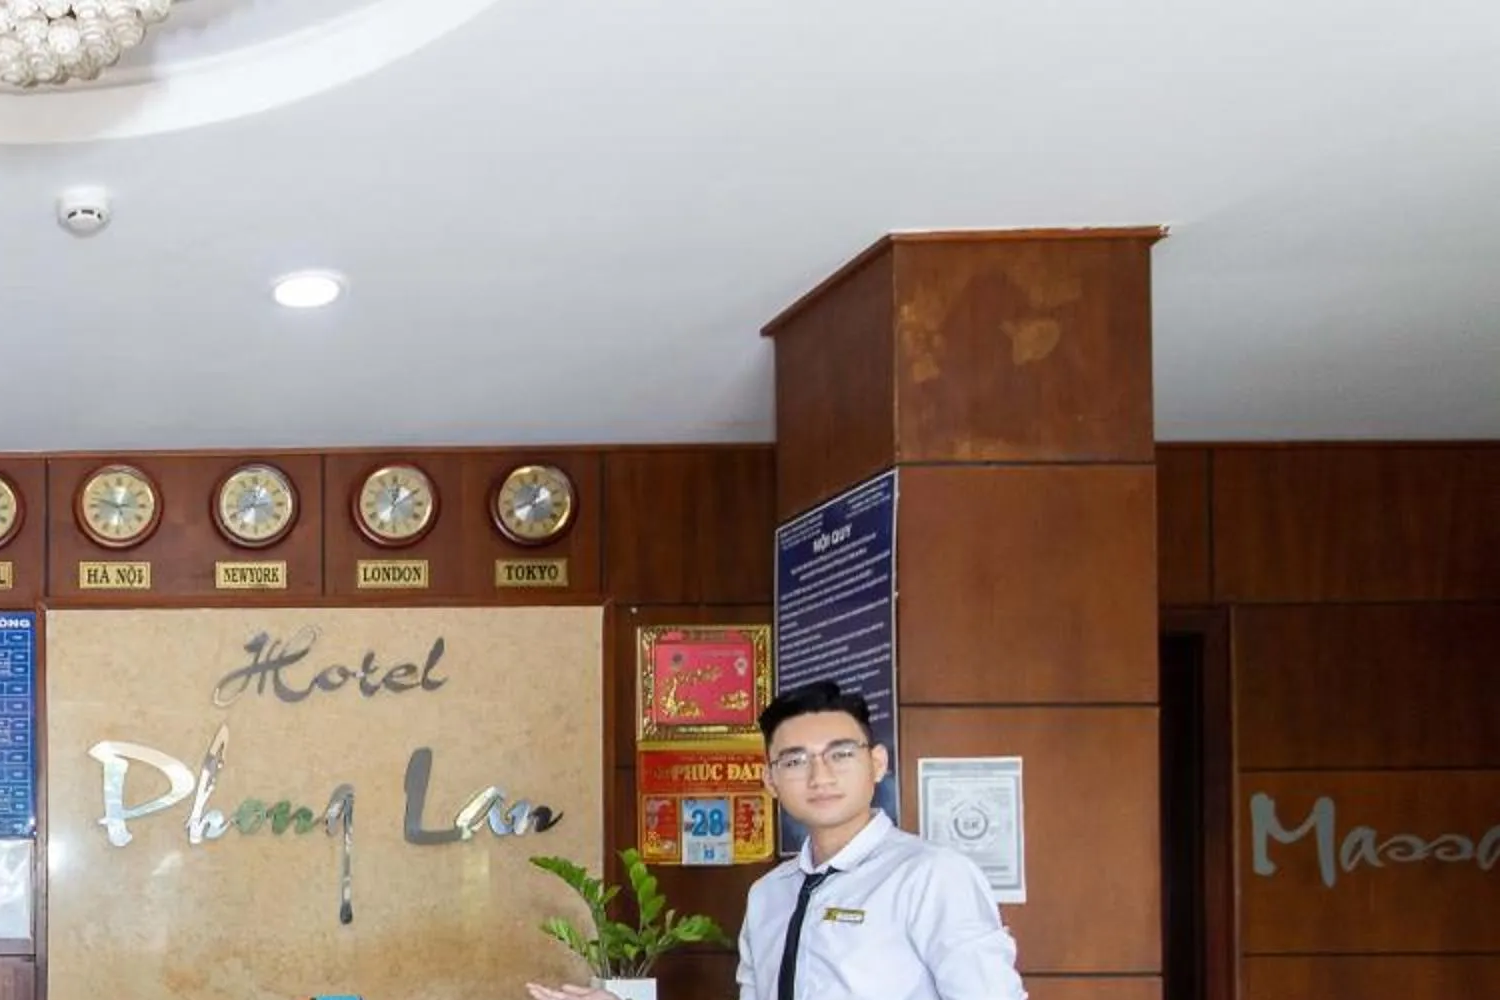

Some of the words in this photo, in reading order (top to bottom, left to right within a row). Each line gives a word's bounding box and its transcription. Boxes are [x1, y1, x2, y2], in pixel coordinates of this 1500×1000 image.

[87, 564, 110, 584] HÀ
[223, 567, 280, 583] NEWYORK
[362, 566, 422, 582] LONDON
[504, 564, 559, 580] TOKYO
[213, 624, 447, 707] Hotel
[88, 724, 354, 925] Phong
[404, 746, 563, 845] Lan
[691, 808, 726, 837] 28
